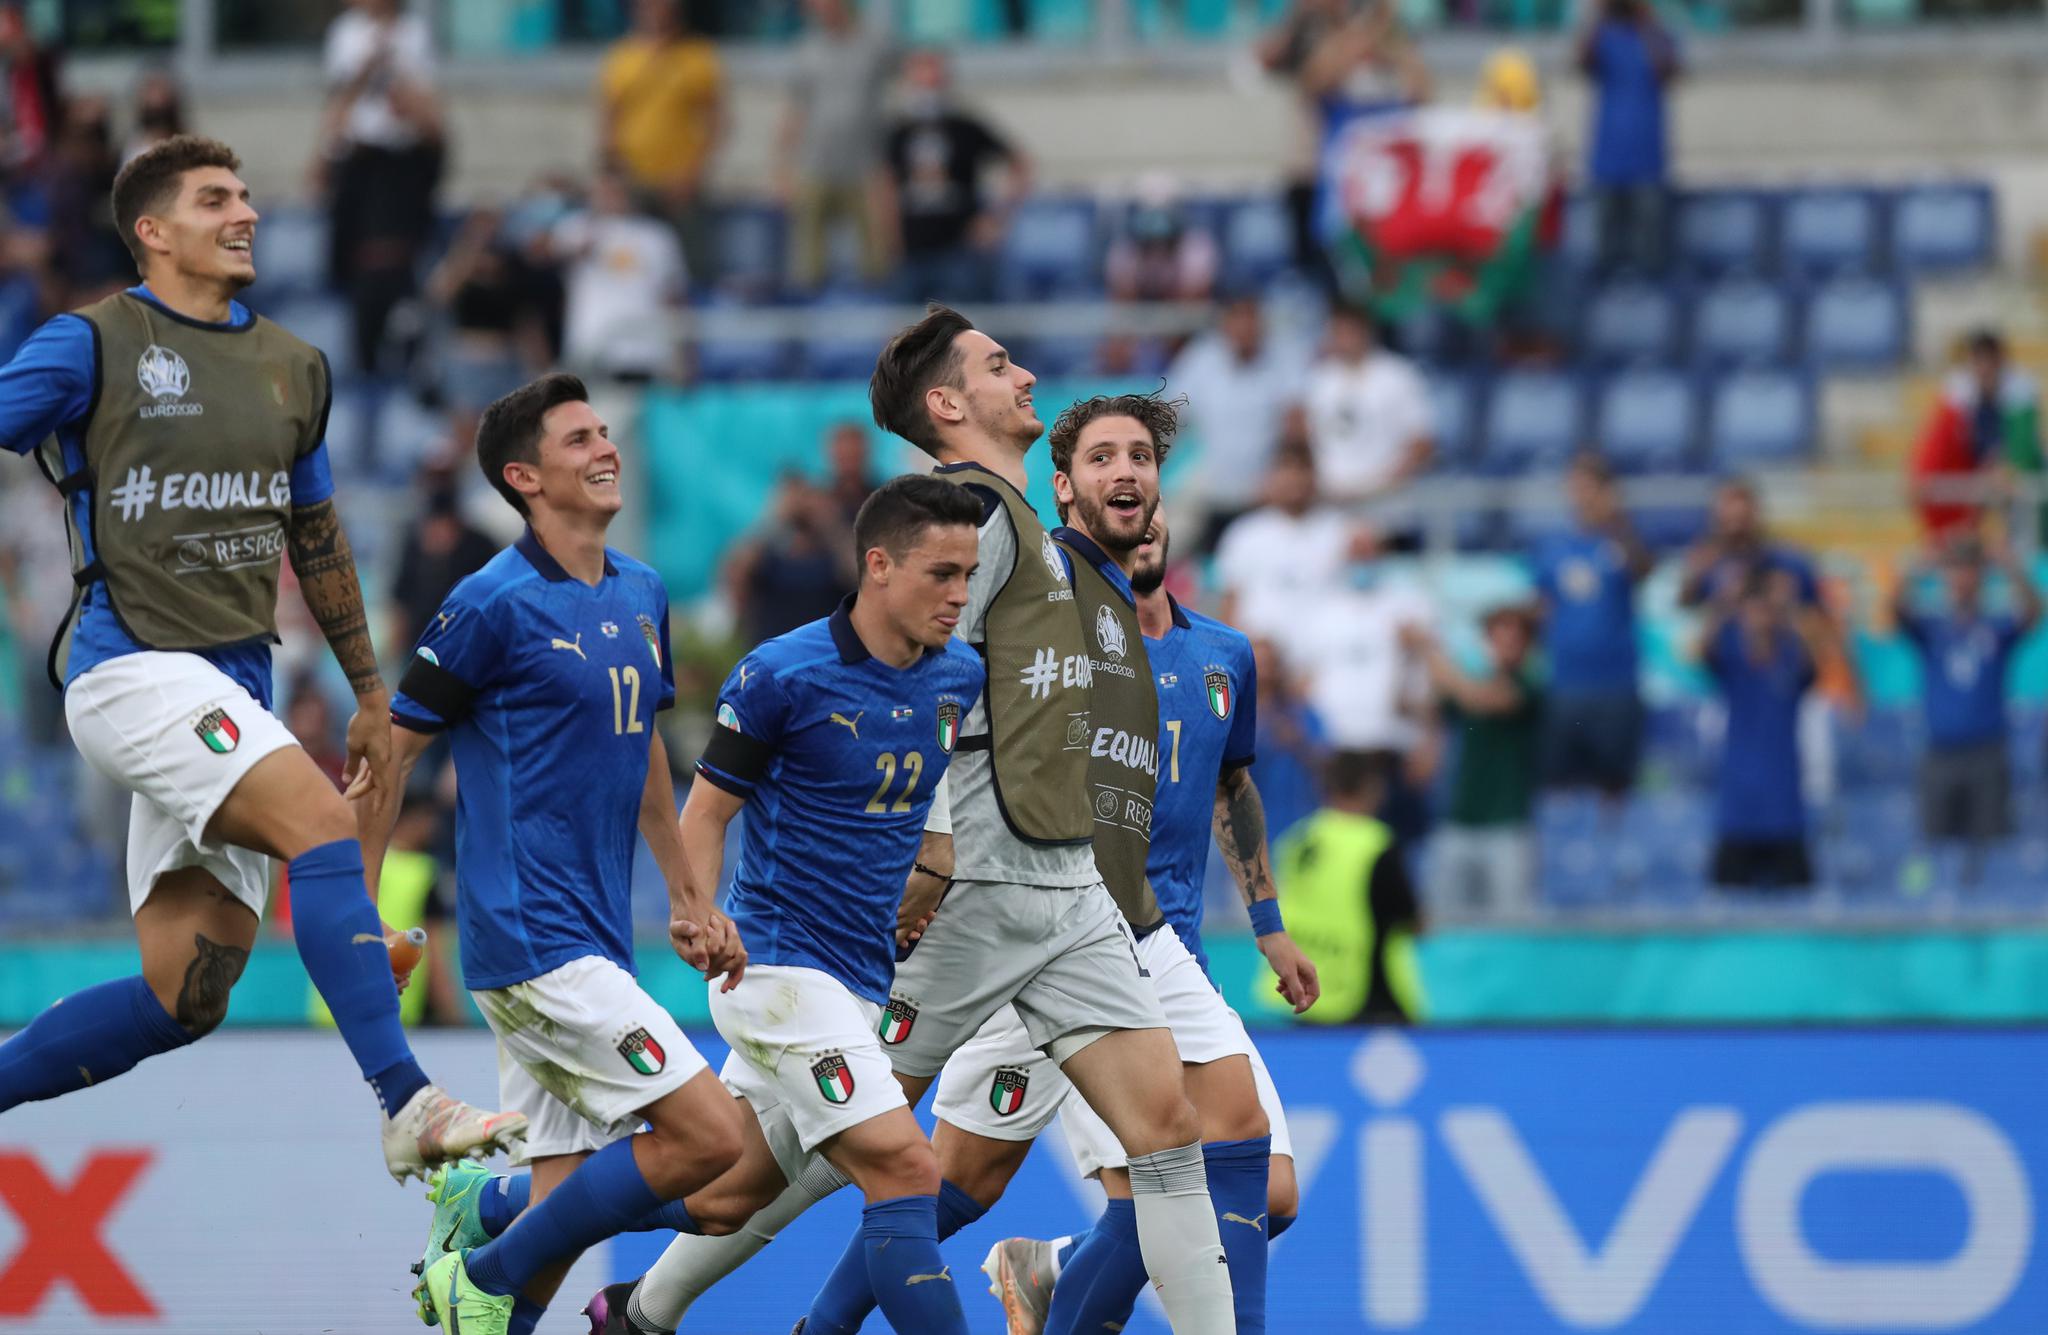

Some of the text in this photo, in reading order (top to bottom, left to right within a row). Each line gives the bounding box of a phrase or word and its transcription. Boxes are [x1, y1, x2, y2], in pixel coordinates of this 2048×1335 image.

[1089, 660, 1136, 679] EURO2020
[607, 665, 645, 736] 12
[1165, 720, 1182, 783] 7
[864, 751, 924, 813] 22
[814, 1057, 844, 1075] ITALIA
[997, 1073, 1027, 1086] ITALIA
